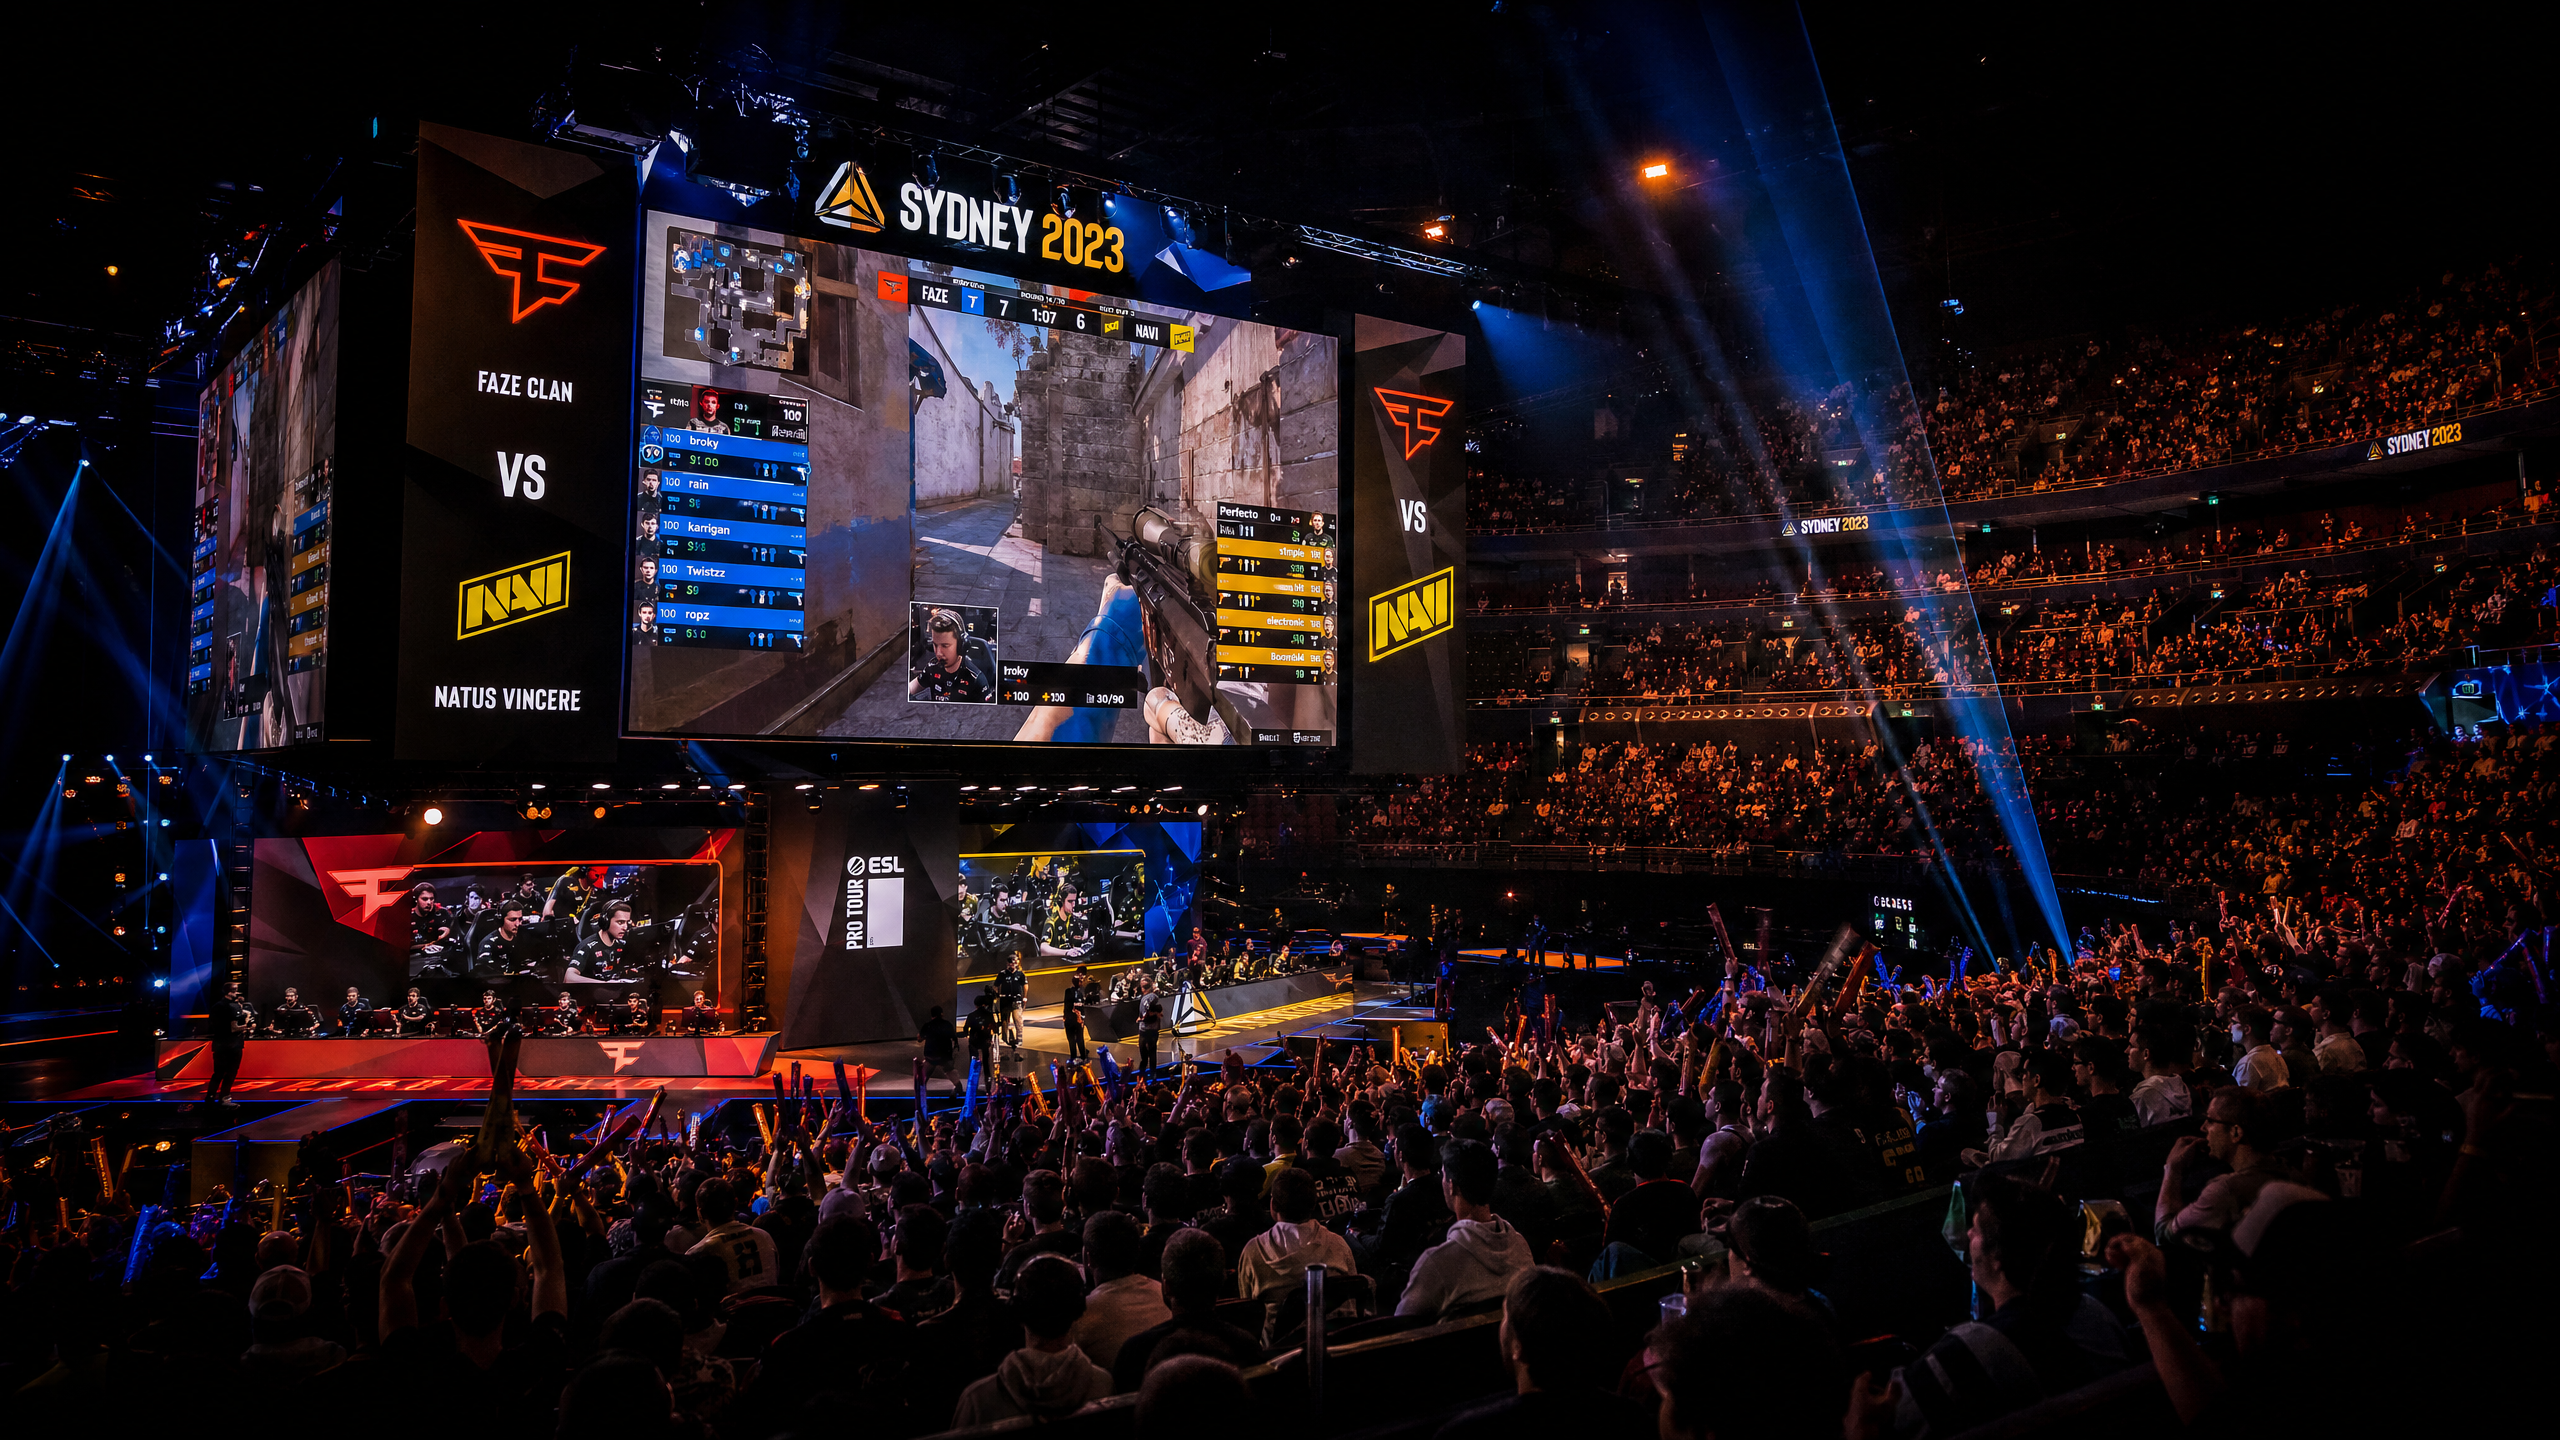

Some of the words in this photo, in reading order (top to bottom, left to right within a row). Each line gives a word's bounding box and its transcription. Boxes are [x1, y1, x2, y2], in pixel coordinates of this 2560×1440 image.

[900, 182, 1034, 254] SYDNEY
[1041, 213, 1125, 274] 2023
[921, 285, 949, 304] FAZE
[999, 299, 1010, 317] 7
[1031, 308, 1057, 325] 1:07
[1076, 313, 1086, 330] 6
[1135, 323, 1159, 341] NAVI
[477, 370, 522, 396] FAZE
[527, 376, 574, 404] CLAN
[783, 408, 802, 421] 100
[665, 433, 681, 443] 100
[689, 435, 719, 450] broky
[2386, 428, 2431, 456] SYDNEY
[2432, 422, 2462, 447] 2023
[496, 451, 547, 500] VS
[664, 476, 681, 487] 100
[688, 479, 709, 491] rain
[1219, 506, 1259, 520] Perfecto
[1400, 498, 1427, 534] VS
[663, 520, 680, 530] 100
[687, 521, 731, 536] karrigan
[1800, 517, 1841, 535] SYDNEY
[1842, 515, 1869, 532] 2023
[661, 564, 678, 574] 100
[686, 565, 726, 578] Twistzz
[660, 608, 676, 619] 100
[685, 610, 710, 622] ropz
[434, 685, 497, 710] NATUS
[502, 688, 582, 712] VINCERE
[1012, 691, 1030, 702] 100
[1096, 693, 1125, 705] 30/90
[868, 856, 905, 874] ESL
[846, 879, 864, 918] TOUR
[846, 920, 863, 950] PRO
